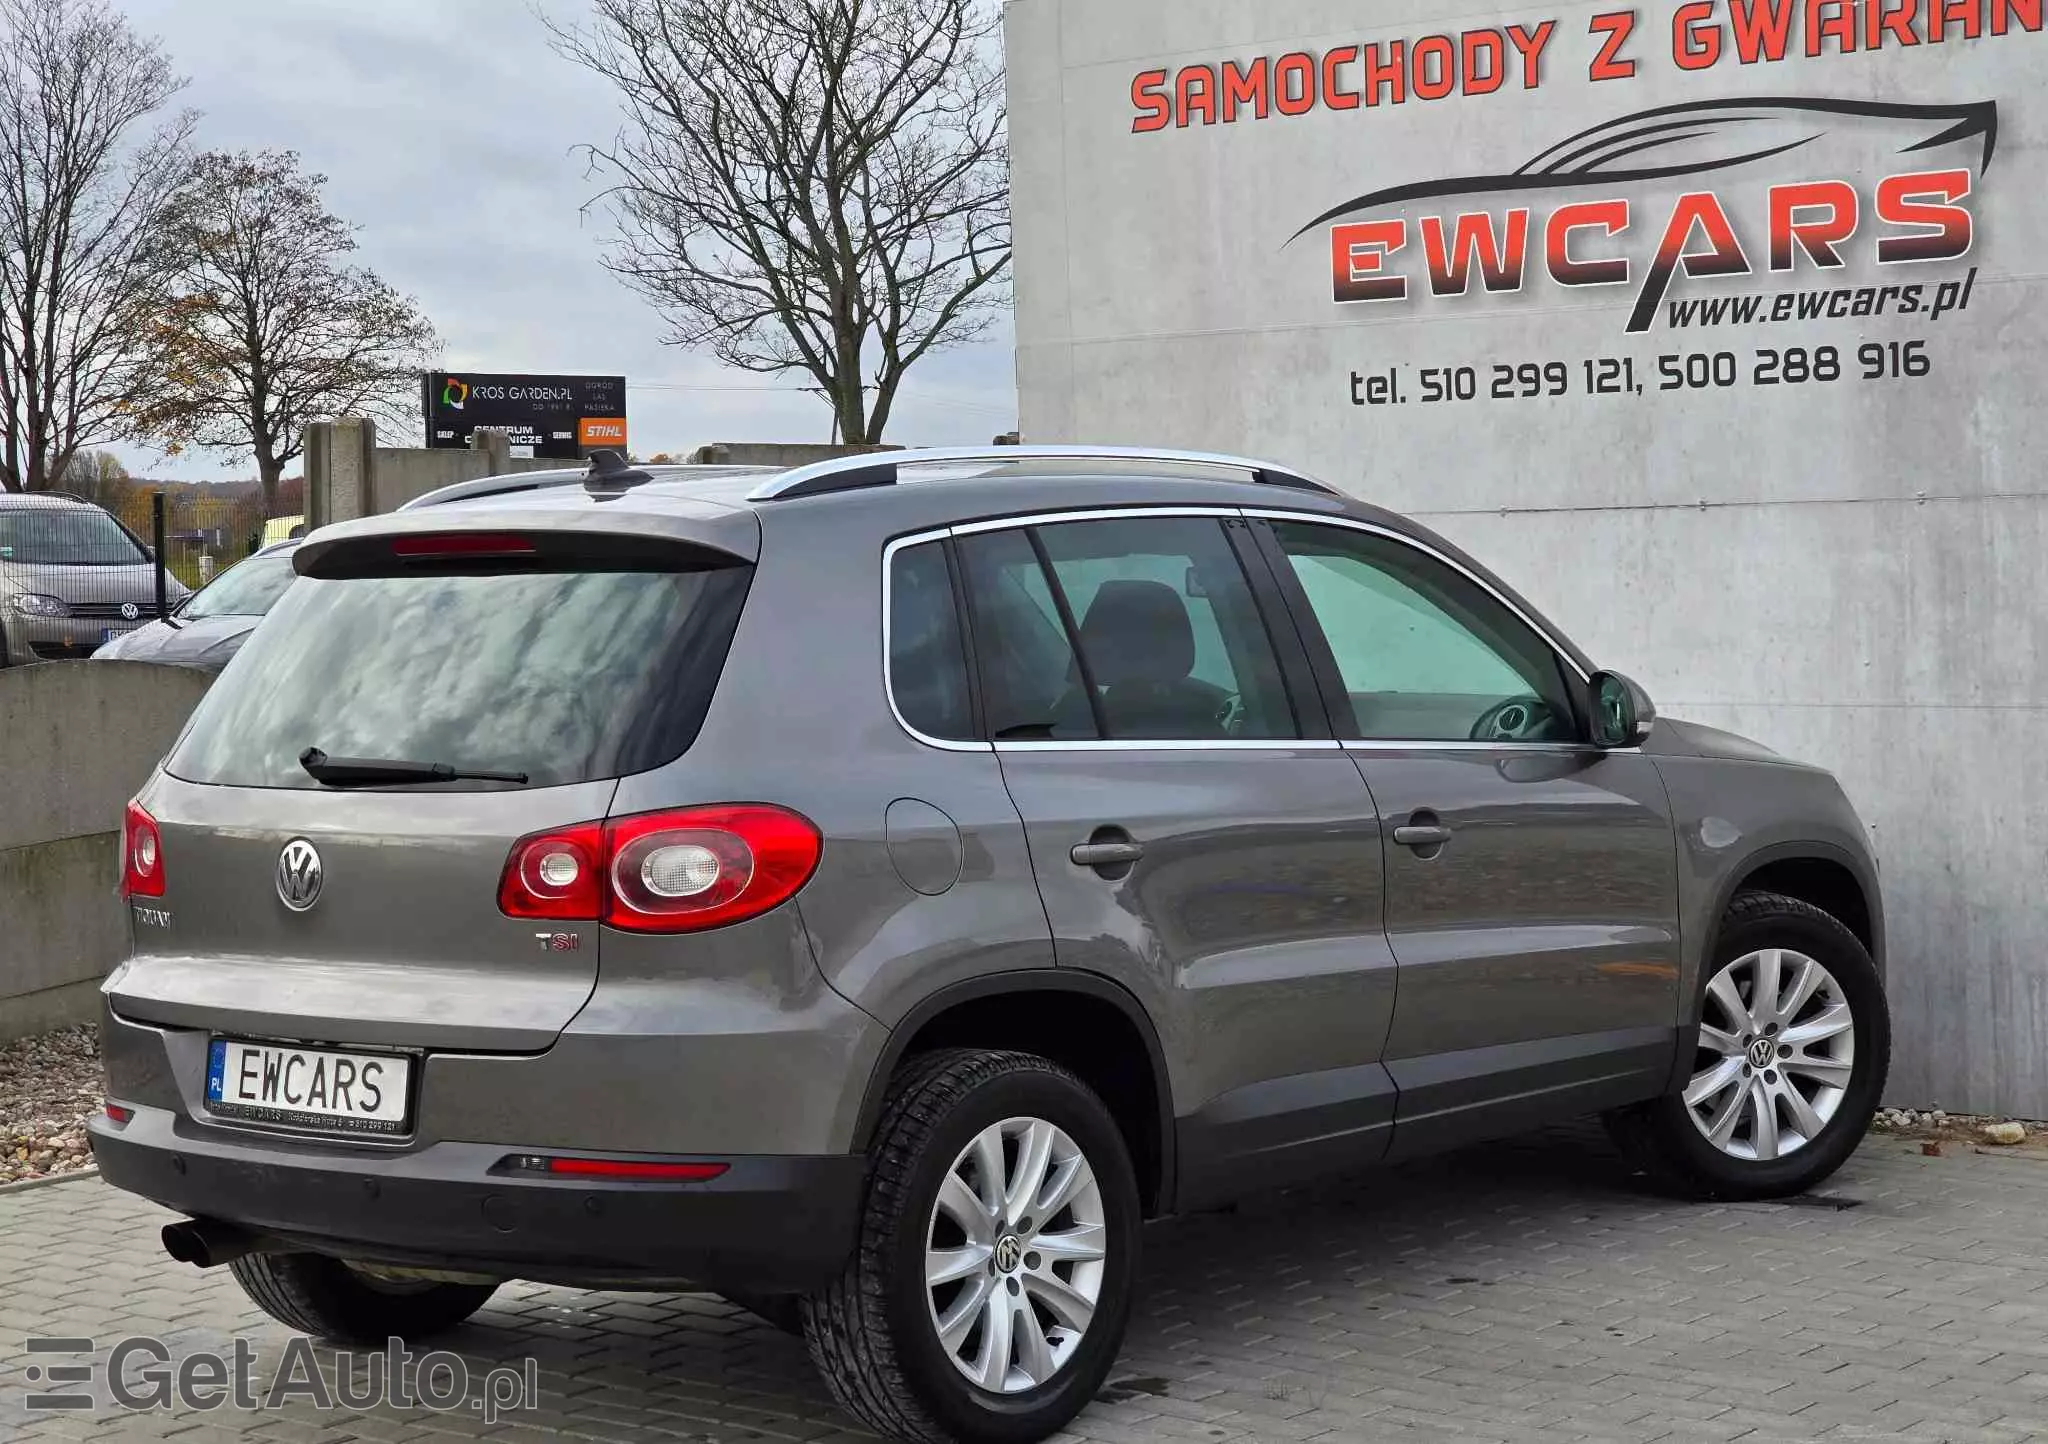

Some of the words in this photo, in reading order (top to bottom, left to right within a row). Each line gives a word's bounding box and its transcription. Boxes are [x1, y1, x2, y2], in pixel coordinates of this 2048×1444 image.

[1131, 20, 1556, 134] SAMOCHODY
[1588, 10, 1636, 82] Z
[1330, 168, 1973, 334] EWCARS
[1669, 267, 1978, 329] www.ewcars.pl
[472, 385, 504, 400] KROS
[509, 386, 573, 400] GARDEN.PL
[1350, 366, 1406, 405] tel.
[1420, 366, 1476, 402] 510
[1491, 361, 1568, 399] 299
[1583, 357, 1643, 396] 121,
[1658, 351, 1737, 390] 500
[1753, 346, 1841, 385] 288
[1857, 340, 1931, 379] 916
[586, 425, 623, 437] STIHL
[535, 933, 578, 951] TSI
[211, 1077, 222, 1091] PL
[238, 1049, 384, 1112] EWCARS
